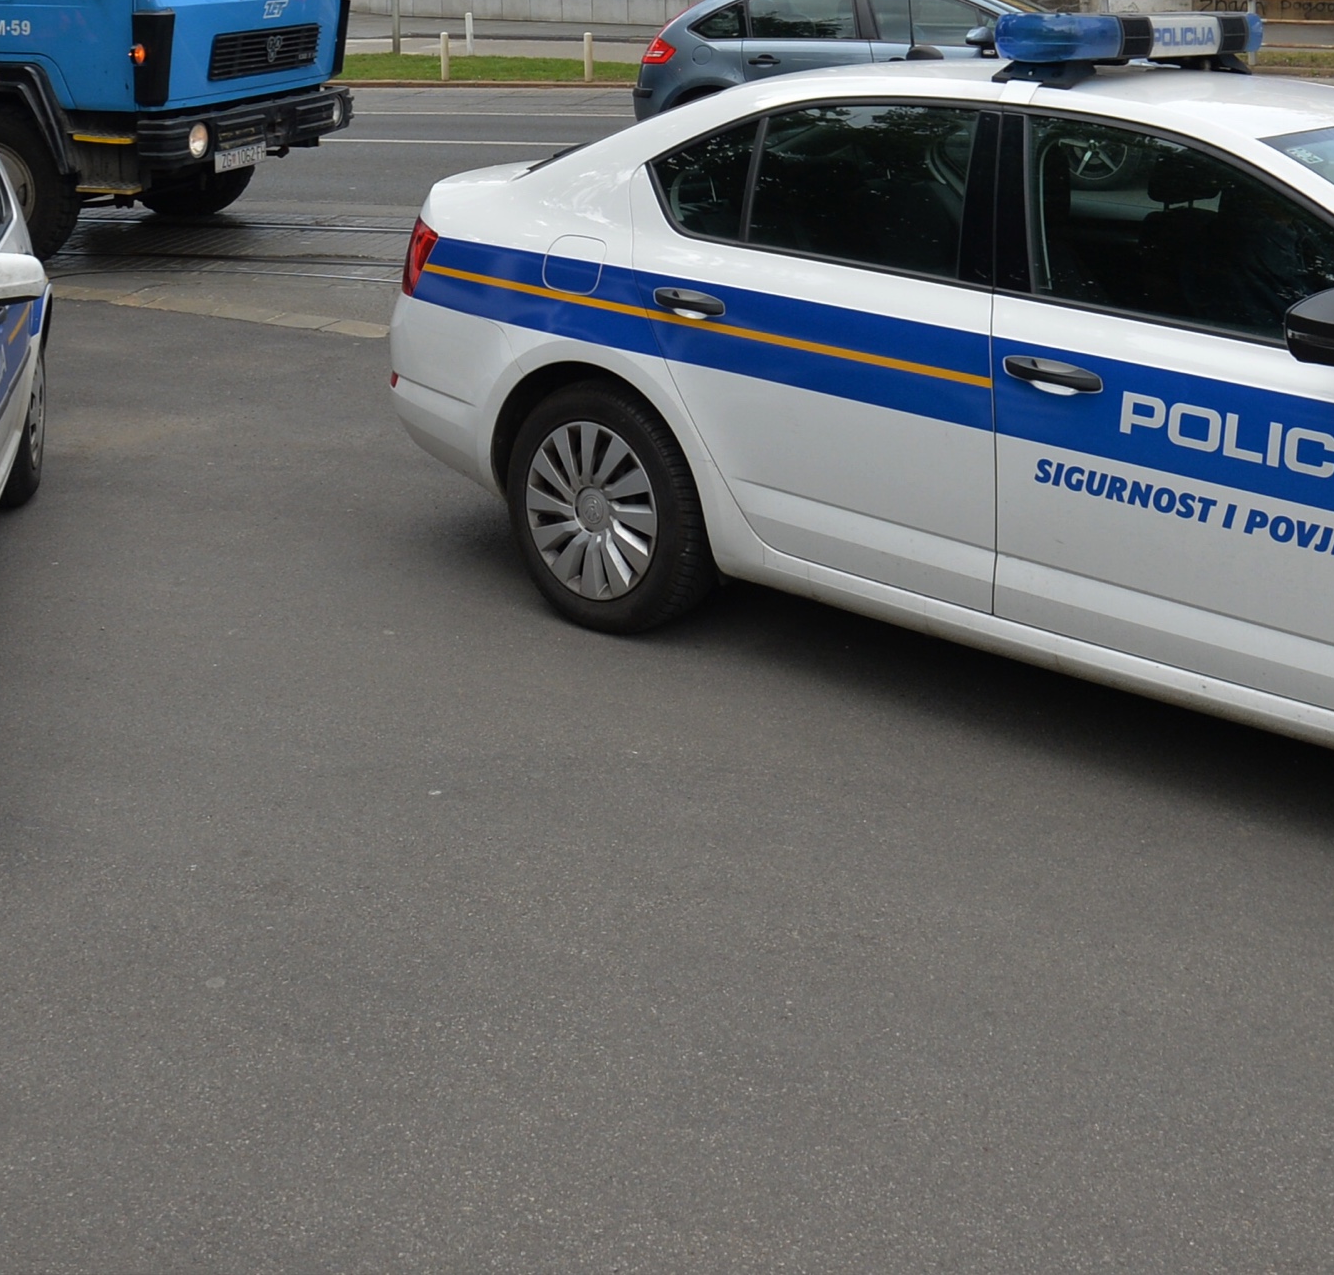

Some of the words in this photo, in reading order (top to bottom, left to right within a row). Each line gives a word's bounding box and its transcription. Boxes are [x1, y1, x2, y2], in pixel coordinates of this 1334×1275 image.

[263, 0, 289, 18] ZET
[1154, 27, 1216, 47] POLICIJA
[222, 153, 232, 168] ZG
[1034, 457, 1218, 523] SIGURNOST
[1222, 503, 1237, 529] I
